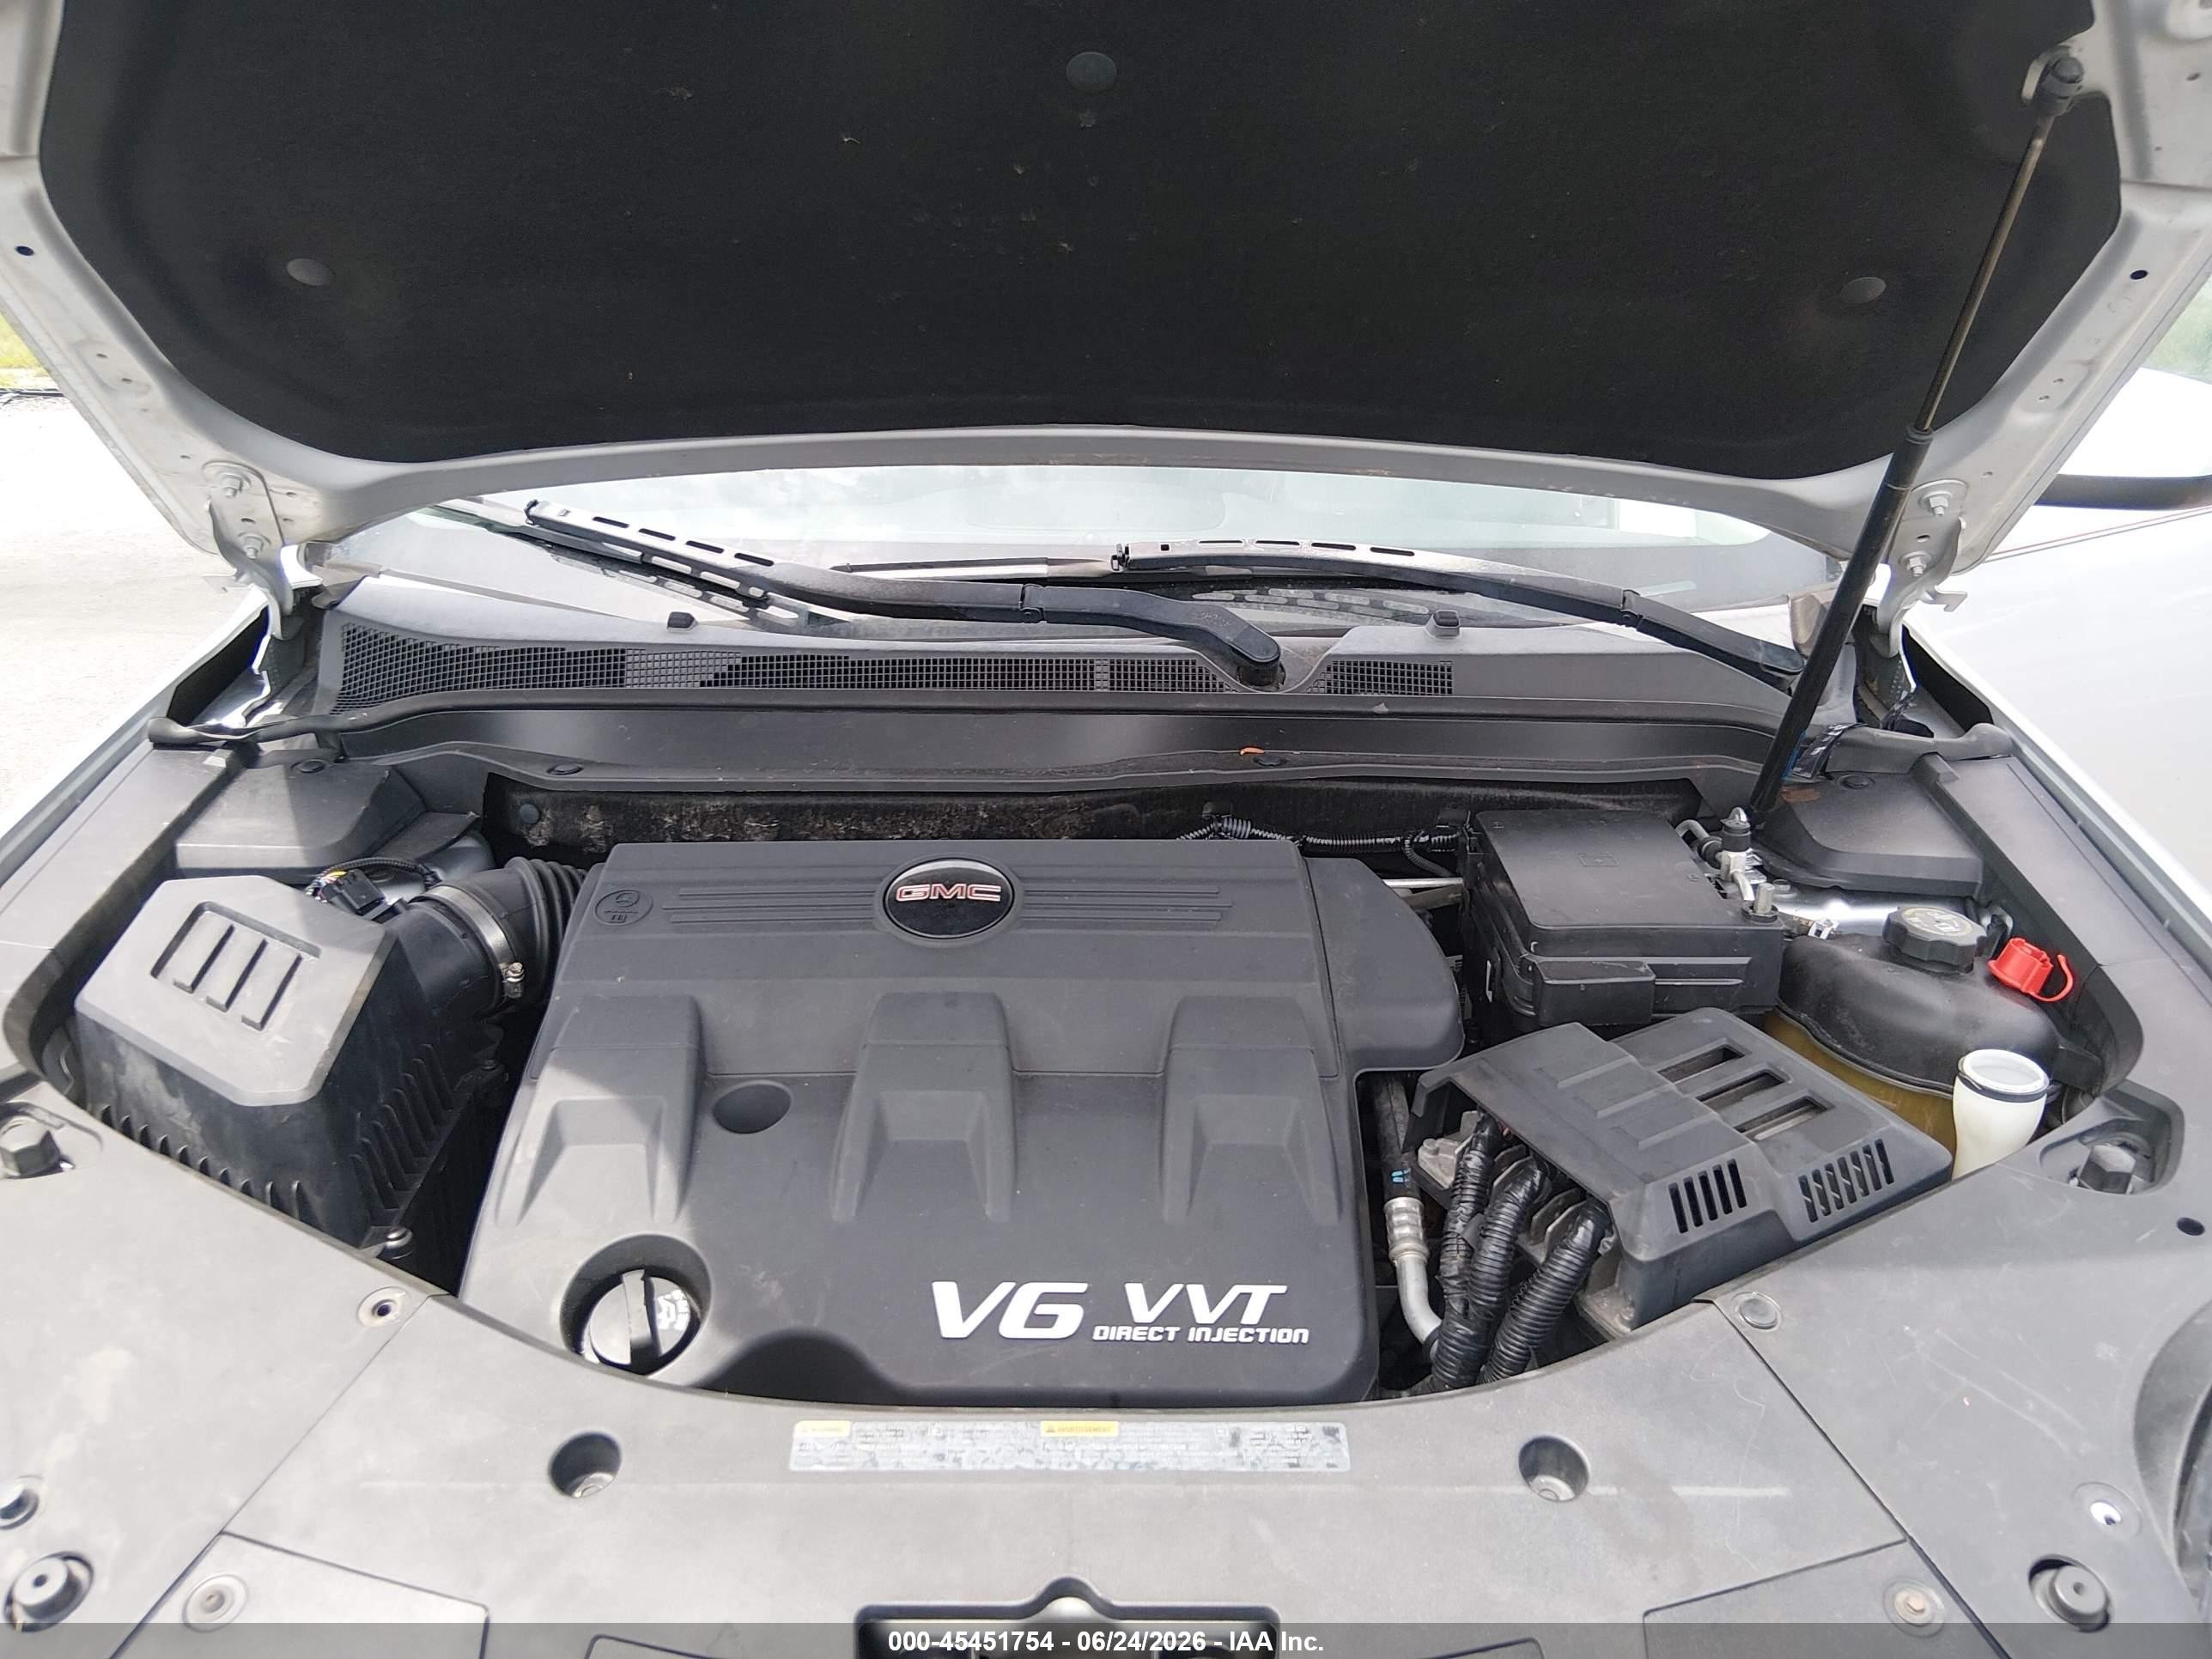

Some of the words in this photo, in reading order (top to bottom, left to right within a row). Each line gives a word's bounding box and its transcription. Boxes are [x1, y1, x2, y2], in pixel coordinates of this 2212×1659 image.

[896, 883, 1002, 902] GMC
[932, 1280, 1089, 1340] V6
[1123, 1282, 1288, 1325] VVT
[1091, 1325, 1182, 1342] DIRECT
[1187, 1327, 1310, 1345] INJECTION
